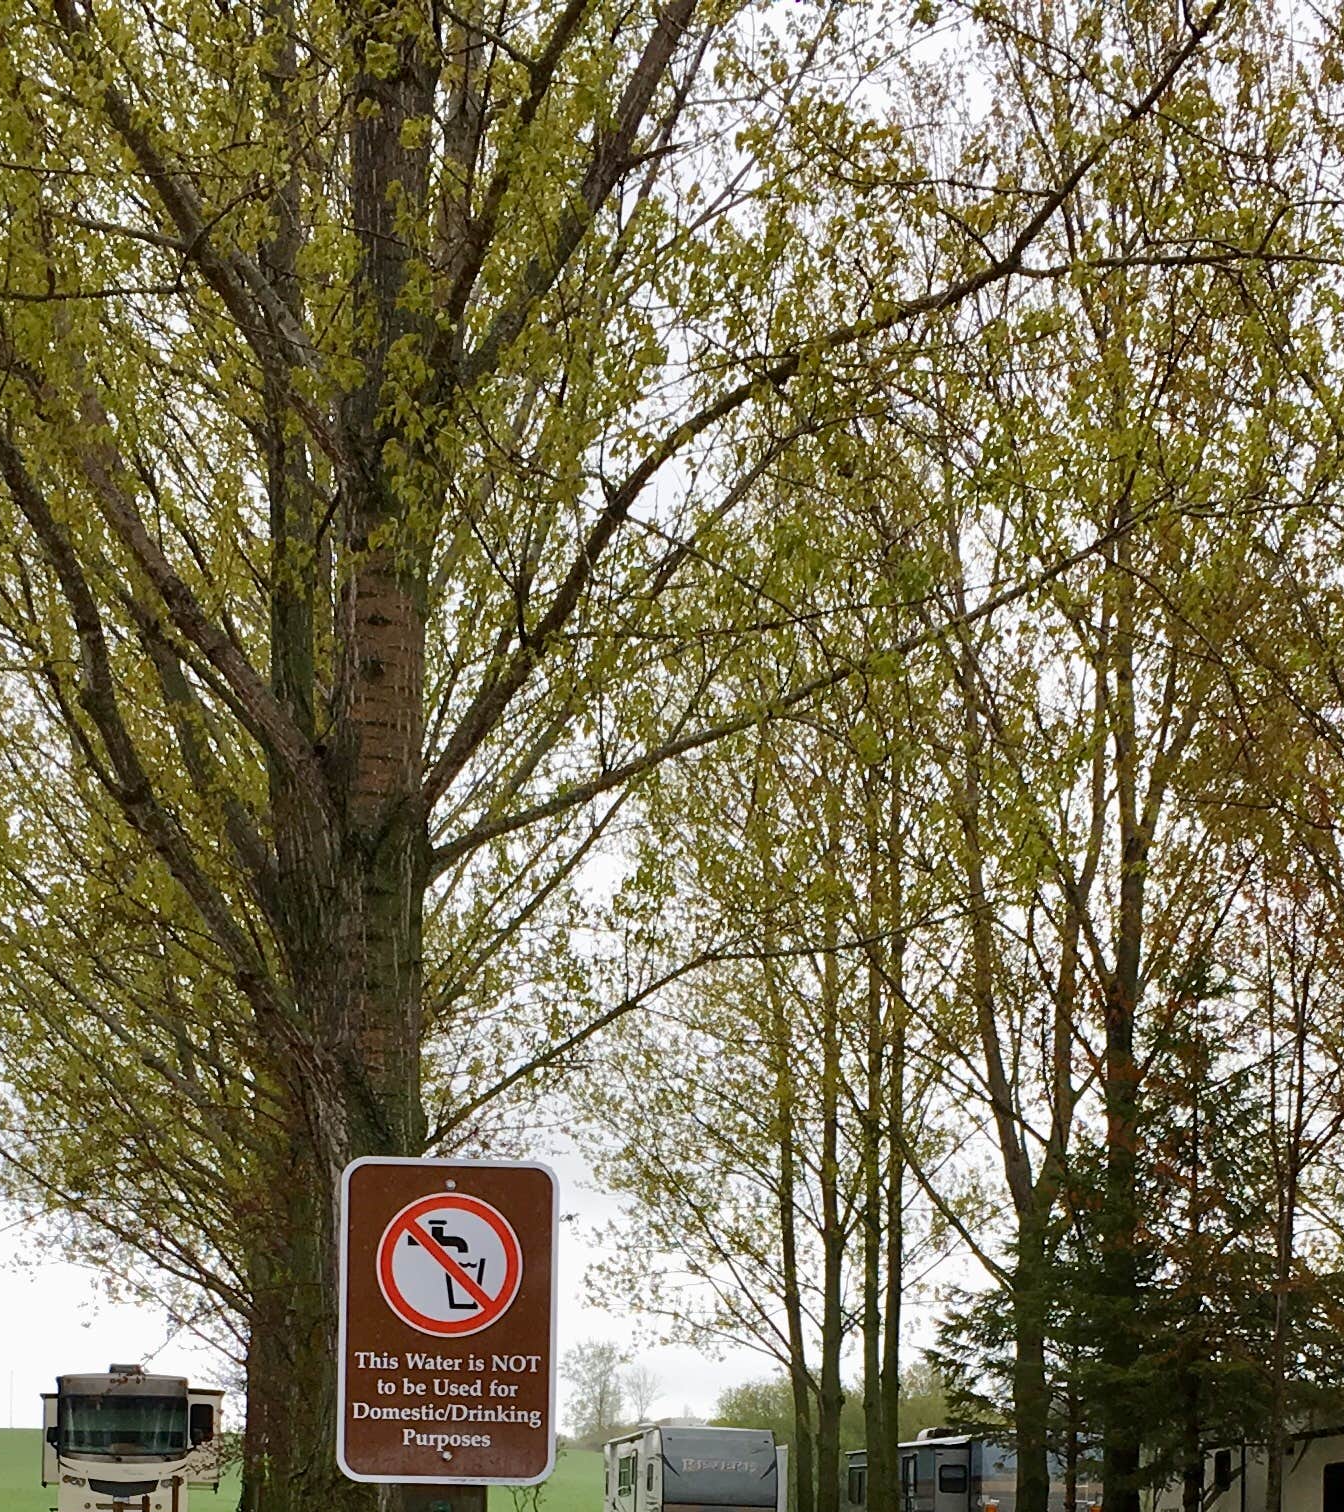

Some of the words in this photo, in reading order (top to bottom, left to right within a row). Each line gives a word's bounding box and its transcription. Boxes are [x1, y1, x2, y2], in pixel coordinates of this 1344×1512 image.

[355, 1352, 399, 1370] This
[406, 1353, 463, 1371] Water
[468, 1354, 485, 1372] is
[491, 1355, 541, 1373] NOT
[377, 1378, 396, 1395] to
[403, 1378, 427, 1395] be
[433, 1379, 483, 1397] Used
[489, 1380, 519, 1398] for
[352, 1402, 542, 1429] Domestic/Drinking
[402, 1428, 492, 1452] Purposes
